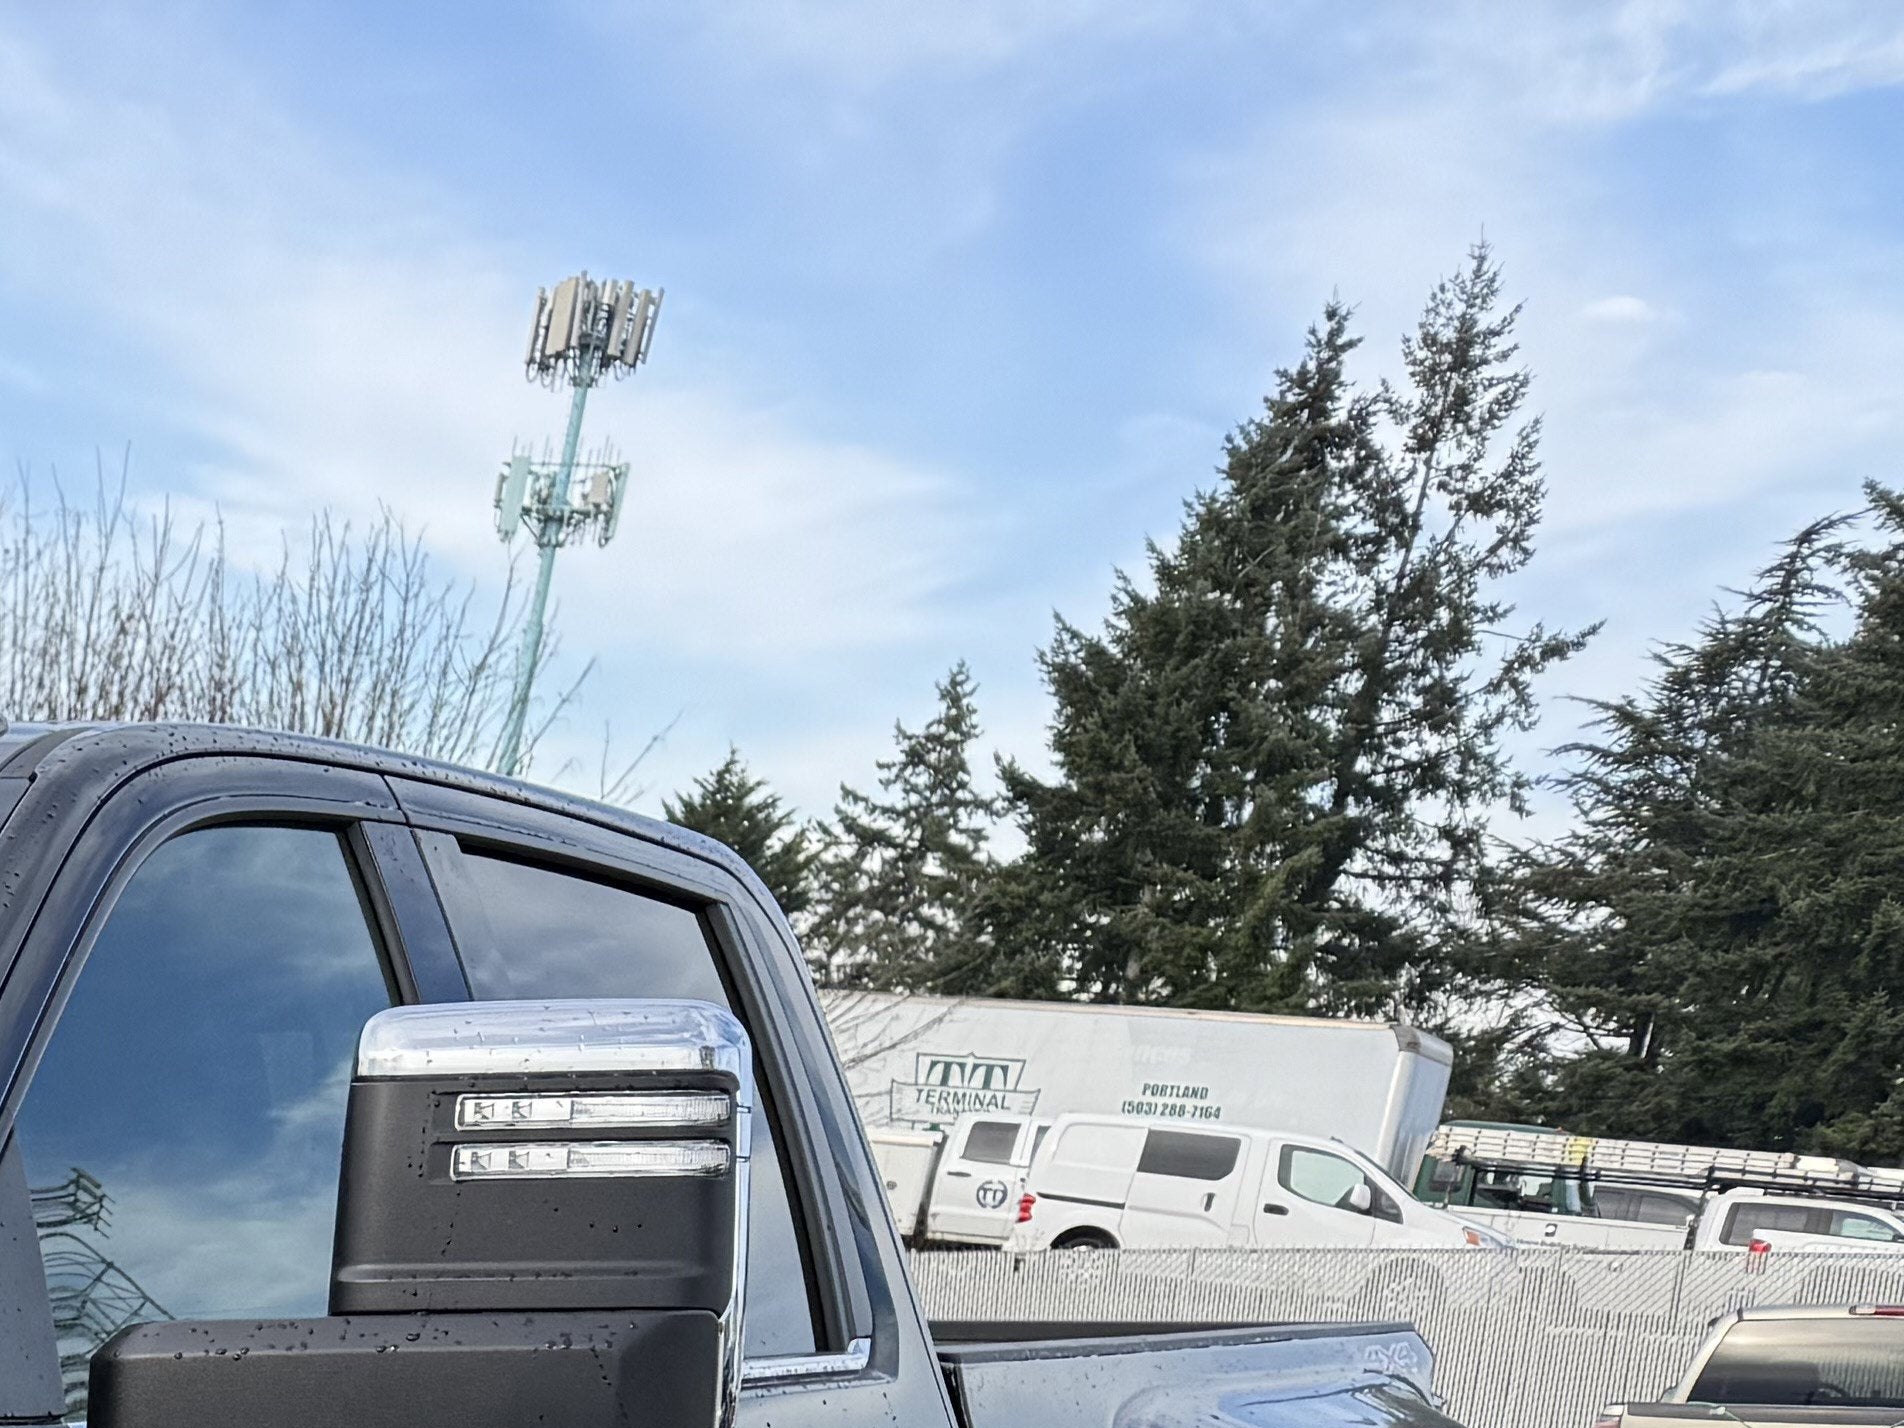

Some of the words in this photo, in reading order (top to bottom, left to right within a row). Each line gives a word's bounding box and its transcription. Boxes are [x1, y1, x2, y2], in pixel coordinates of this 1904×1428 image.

[916, 1088, 1011, 1111] TERMINAL
[1141, 1083, 1209, 1100] PORTLAND
[1121, 1100, 1158, 1116] (503)
